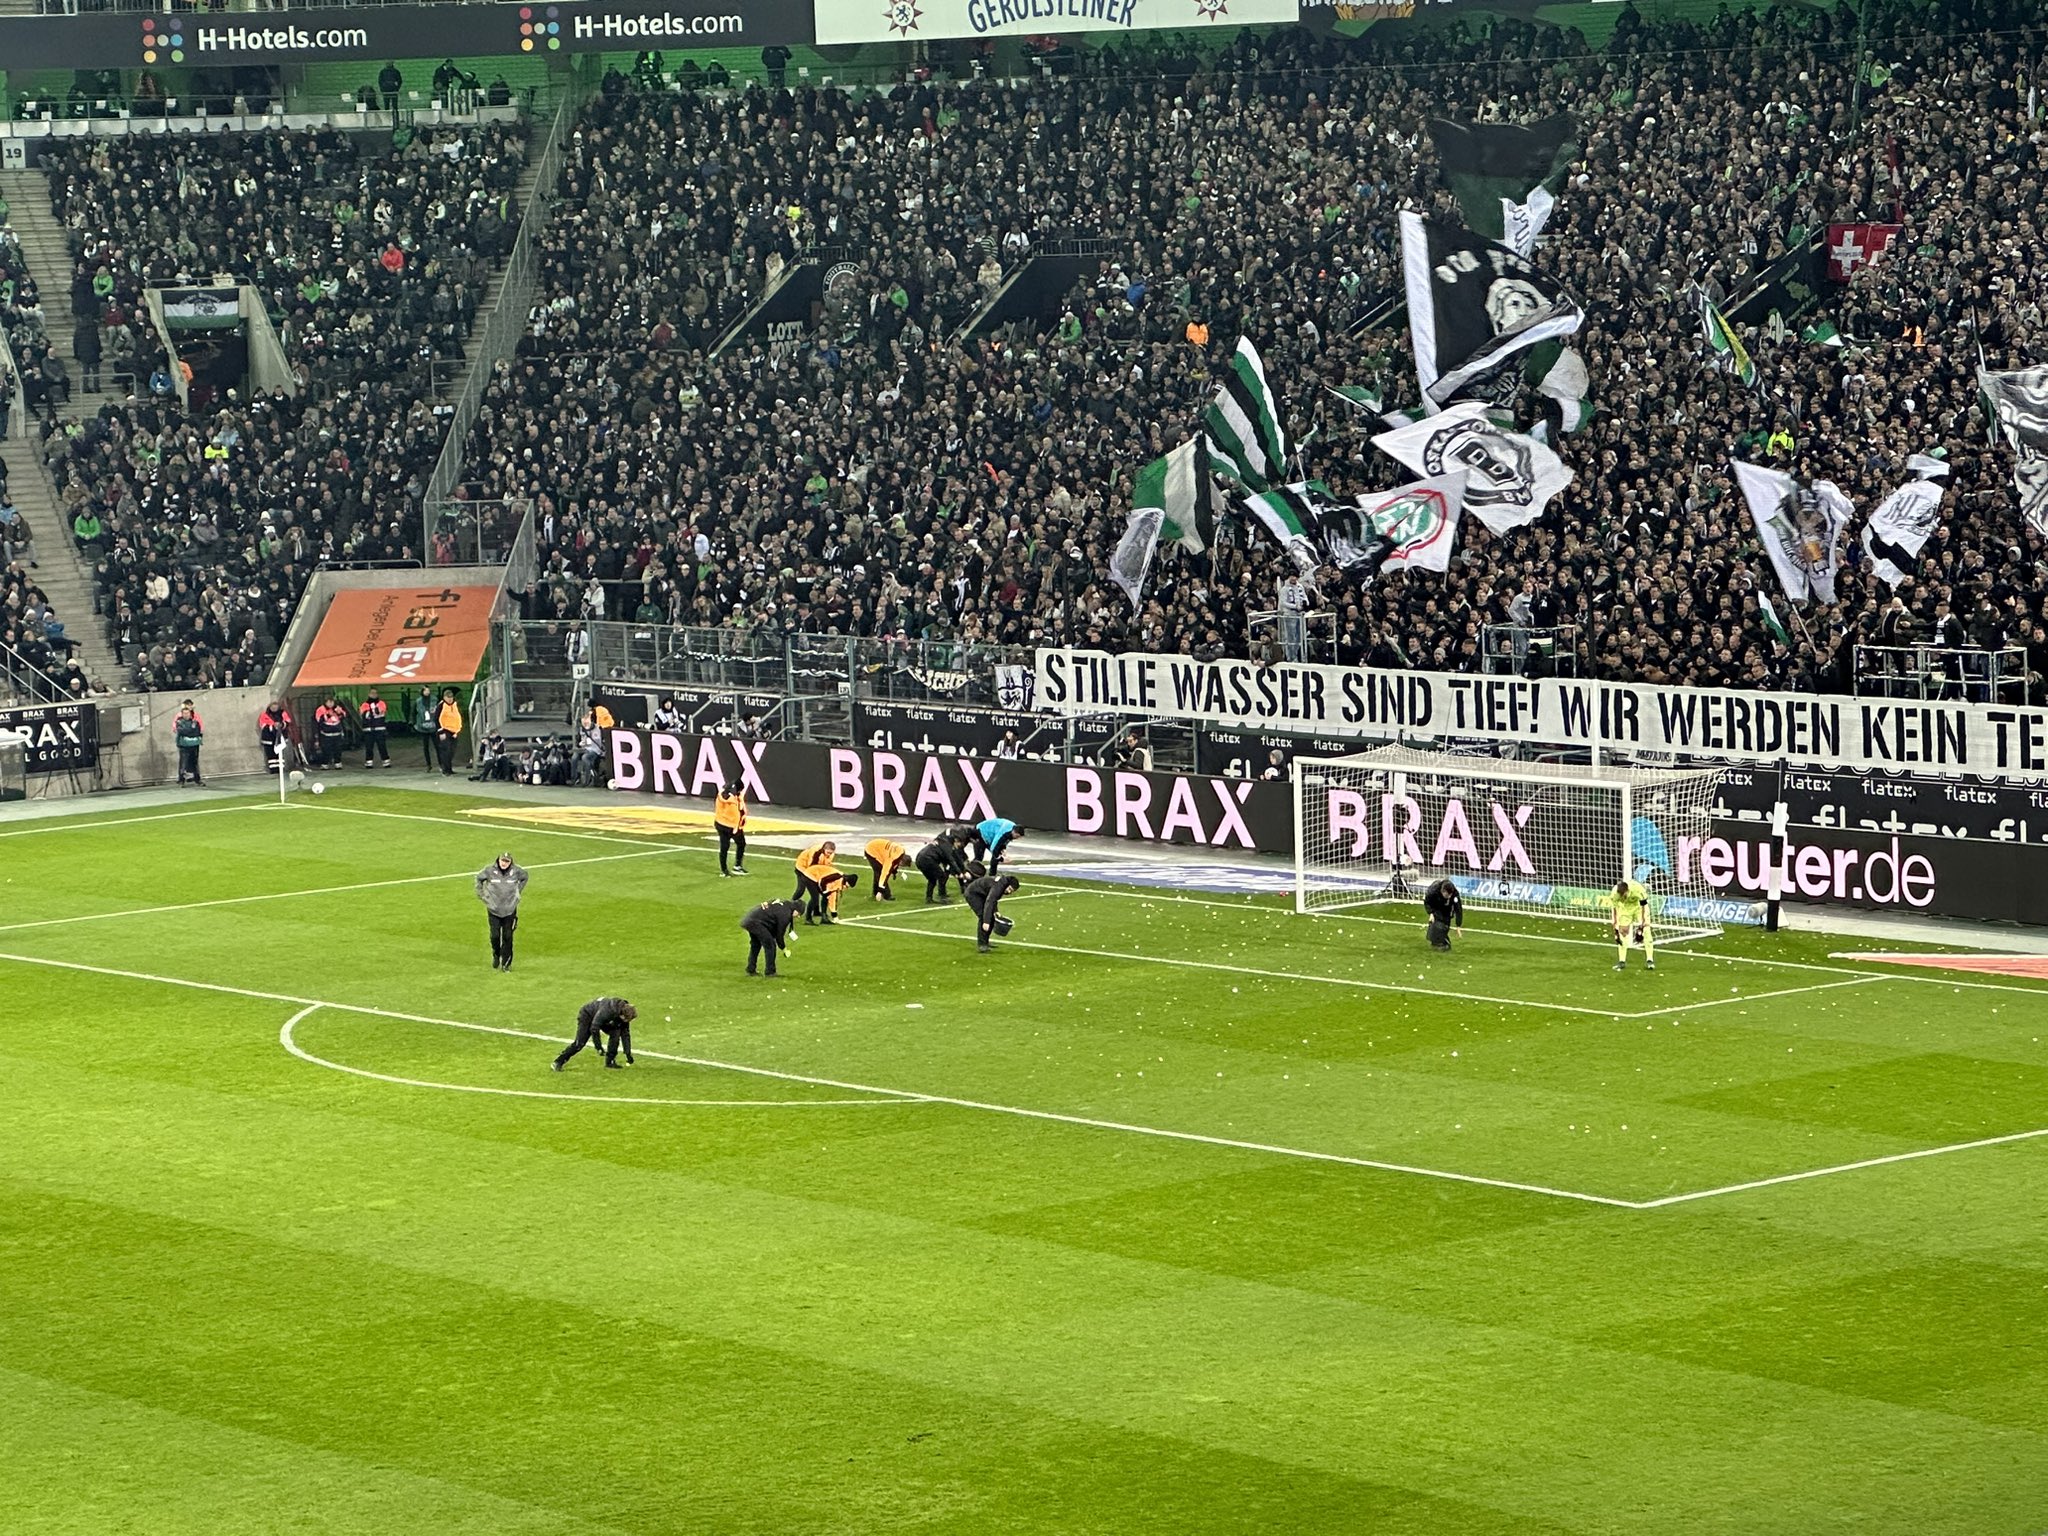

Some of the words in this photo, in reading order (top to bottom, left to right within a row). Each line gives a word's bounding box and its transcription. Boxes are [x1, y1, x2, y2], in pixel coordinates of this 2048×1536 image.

[198, 26, 367, 50] H-Hotels.com
[574, 12, 743, 39] H-Hotels.com
[6, 148, 22, 158] 19
[1045, 653, 1157, 708] STILLE
[1171, 662, 1325, 720] WASSER
[1342, 672, 1433, 727] SIND
[1448, 679, 1540, 733] TIEF!
[1559, 685, 1639, 741] WIR
[1657, 692, 1840, 756] WERDEN
[1862, 705, 1967, 764] KEIN
[1987, 711, 2045, 770] TE
[611, 729, 770, 802] BRAX
[830, 748, 997, 820] BRAX
[1066, 767, 1256, 849] BRAX
[1327, 788, 1537, 875] BRAX
[1677, 836, 1936, 907] reuter.de
